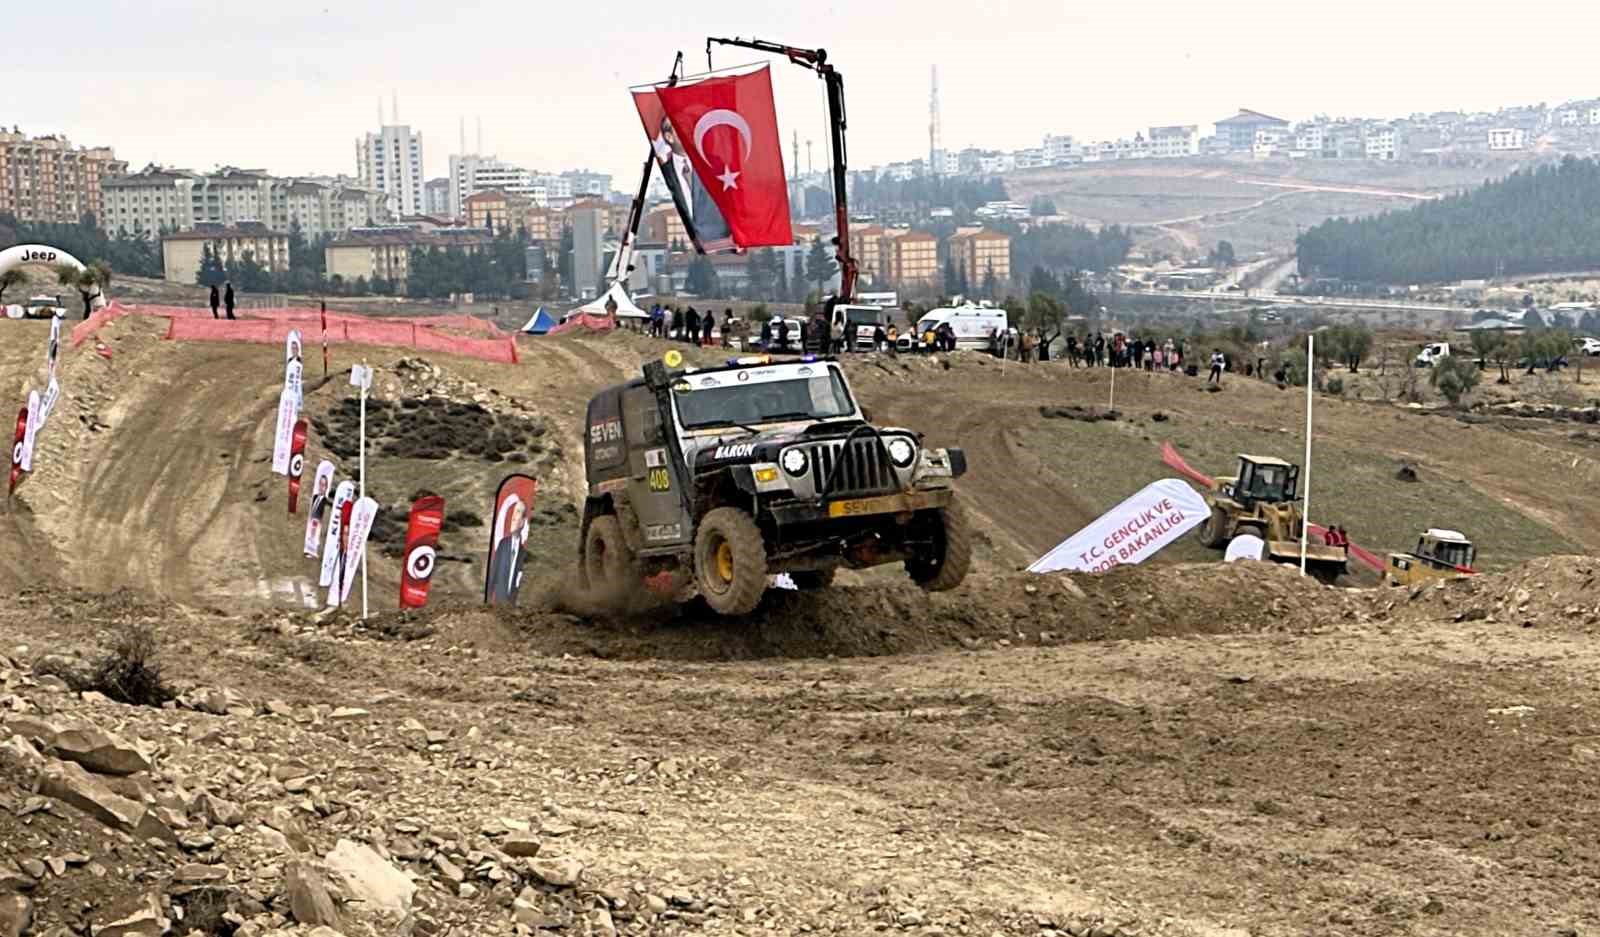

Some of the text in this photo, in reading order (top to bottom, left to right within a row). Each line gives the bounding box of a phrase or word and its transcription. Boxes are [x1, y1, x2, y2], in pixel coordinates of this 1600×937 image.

[21, 249, 57, 261] Jeep
[590, 420, 624, 444] SEVEN
[714, 442, 758, 459] BARON
[649, 469, 670, 490] 408
[1079, 498, 1173, 565] T.C. GENÇLİK VE
